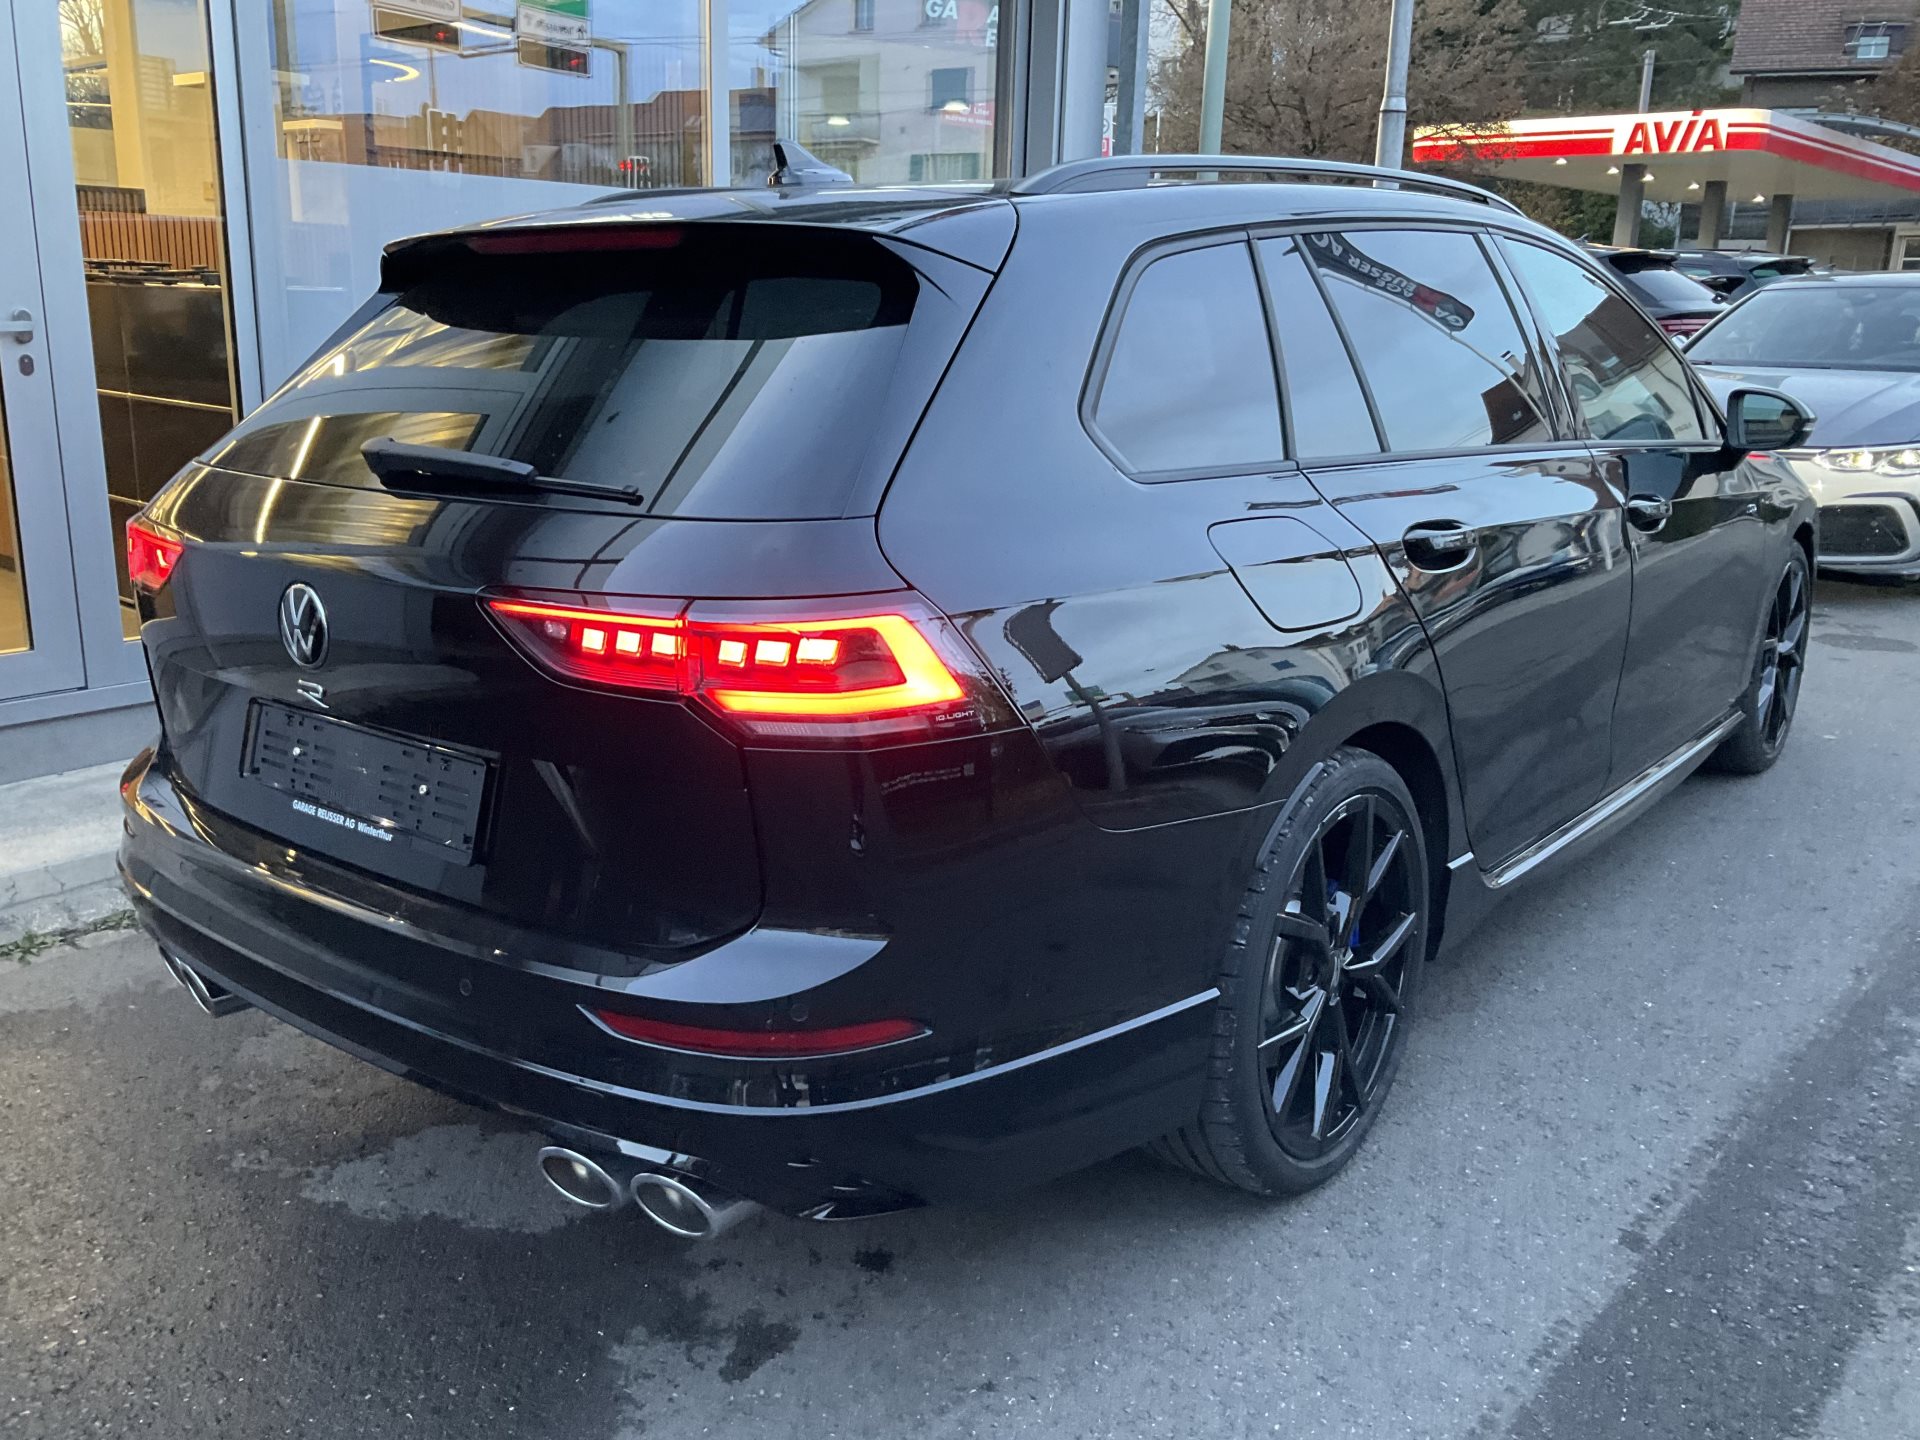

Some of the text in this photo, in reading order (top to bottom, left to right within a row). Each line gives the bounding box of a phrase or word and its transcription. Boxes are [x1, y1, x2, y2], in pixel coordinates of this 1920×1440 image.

[1623, 109, 1724, 153] AVIA
[292, 799, 394, 841] GARAGE REUSSER AG Winterthur
